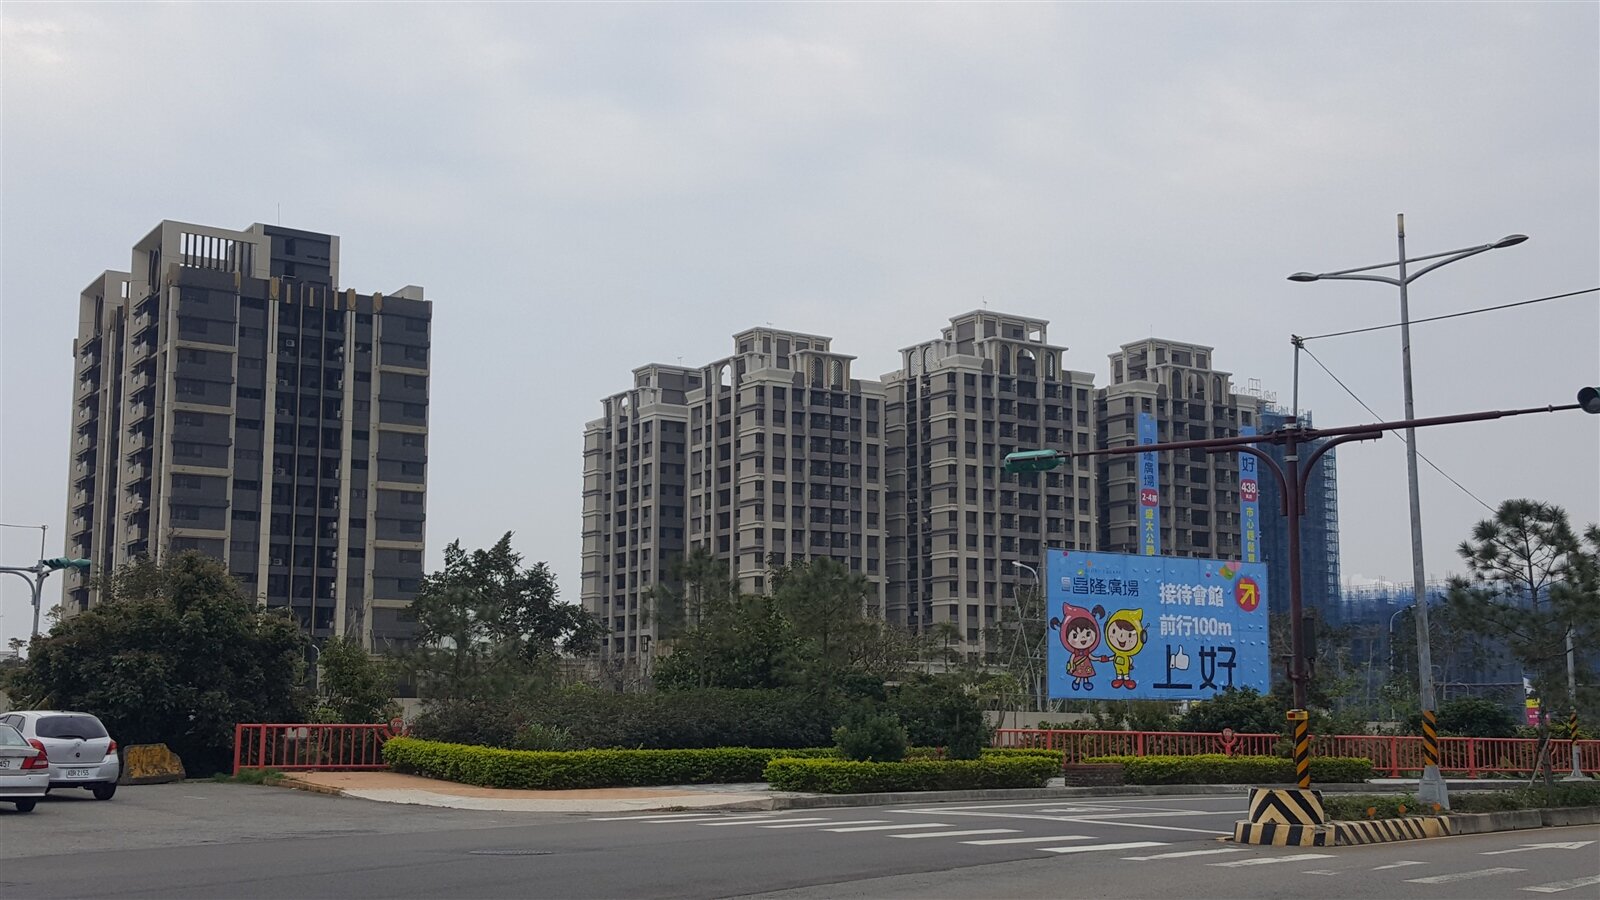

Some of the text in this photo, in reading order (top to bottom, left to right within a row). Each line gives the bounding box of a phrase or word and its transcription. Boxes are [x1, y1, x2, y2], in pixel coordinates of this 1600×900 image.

[1241, 482, 1256, 494] 438
[1072, 577, 1139, 597] 昌隆廣場
[1159, 581, 1224, 607] 接待會館
[1159, 614, 1232, 637] 前行100m
[1153, 644, 1237, 691] 上好
